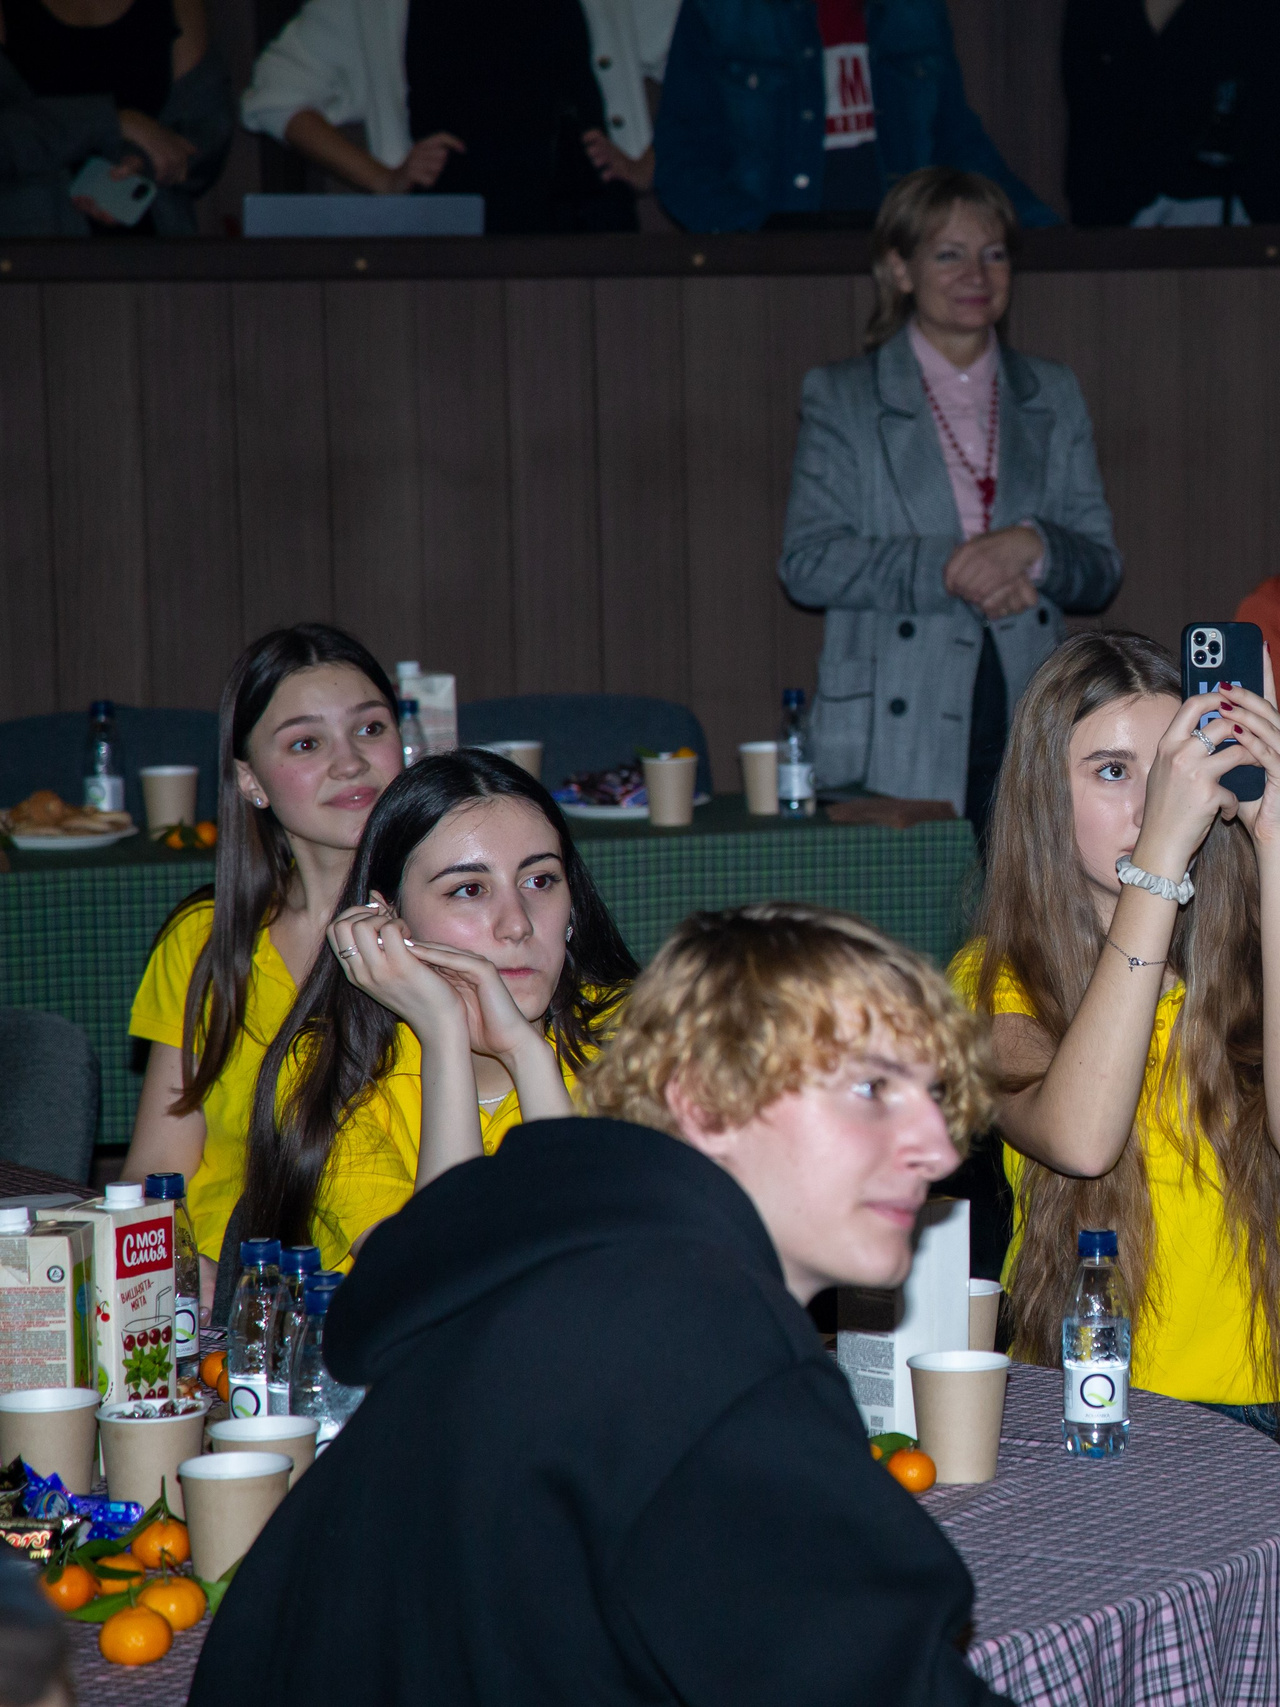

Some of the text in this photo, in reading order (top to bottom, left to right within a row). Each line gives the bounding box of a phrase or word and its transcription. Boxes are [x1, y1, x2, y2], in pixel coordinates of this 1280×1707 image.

[122, 1233, 168, 1267] Семья
[136, 1228, 166, 1249] МОЯ
[1080, 1373, 1118, 1409] Q
